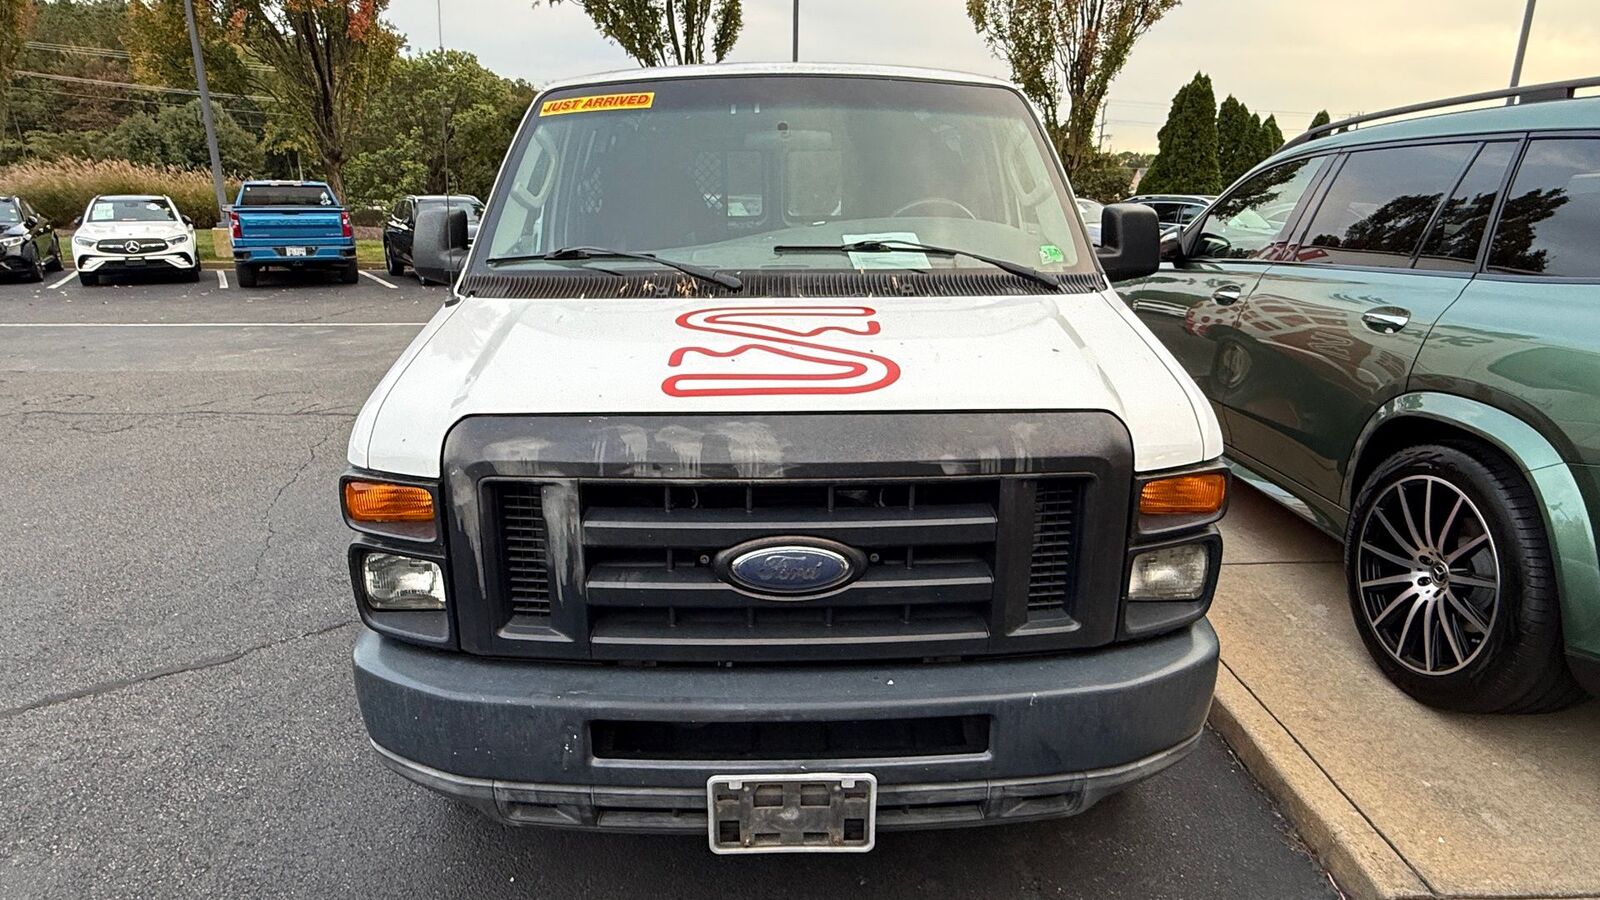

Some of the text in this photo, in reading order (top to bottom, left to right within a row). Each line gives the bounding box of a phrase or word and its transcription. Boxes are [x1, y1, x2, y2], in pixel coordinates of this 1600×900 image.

[543, 94, 651, 113] JUST ARRIVED
[758, 555, 824, 580] Ford
